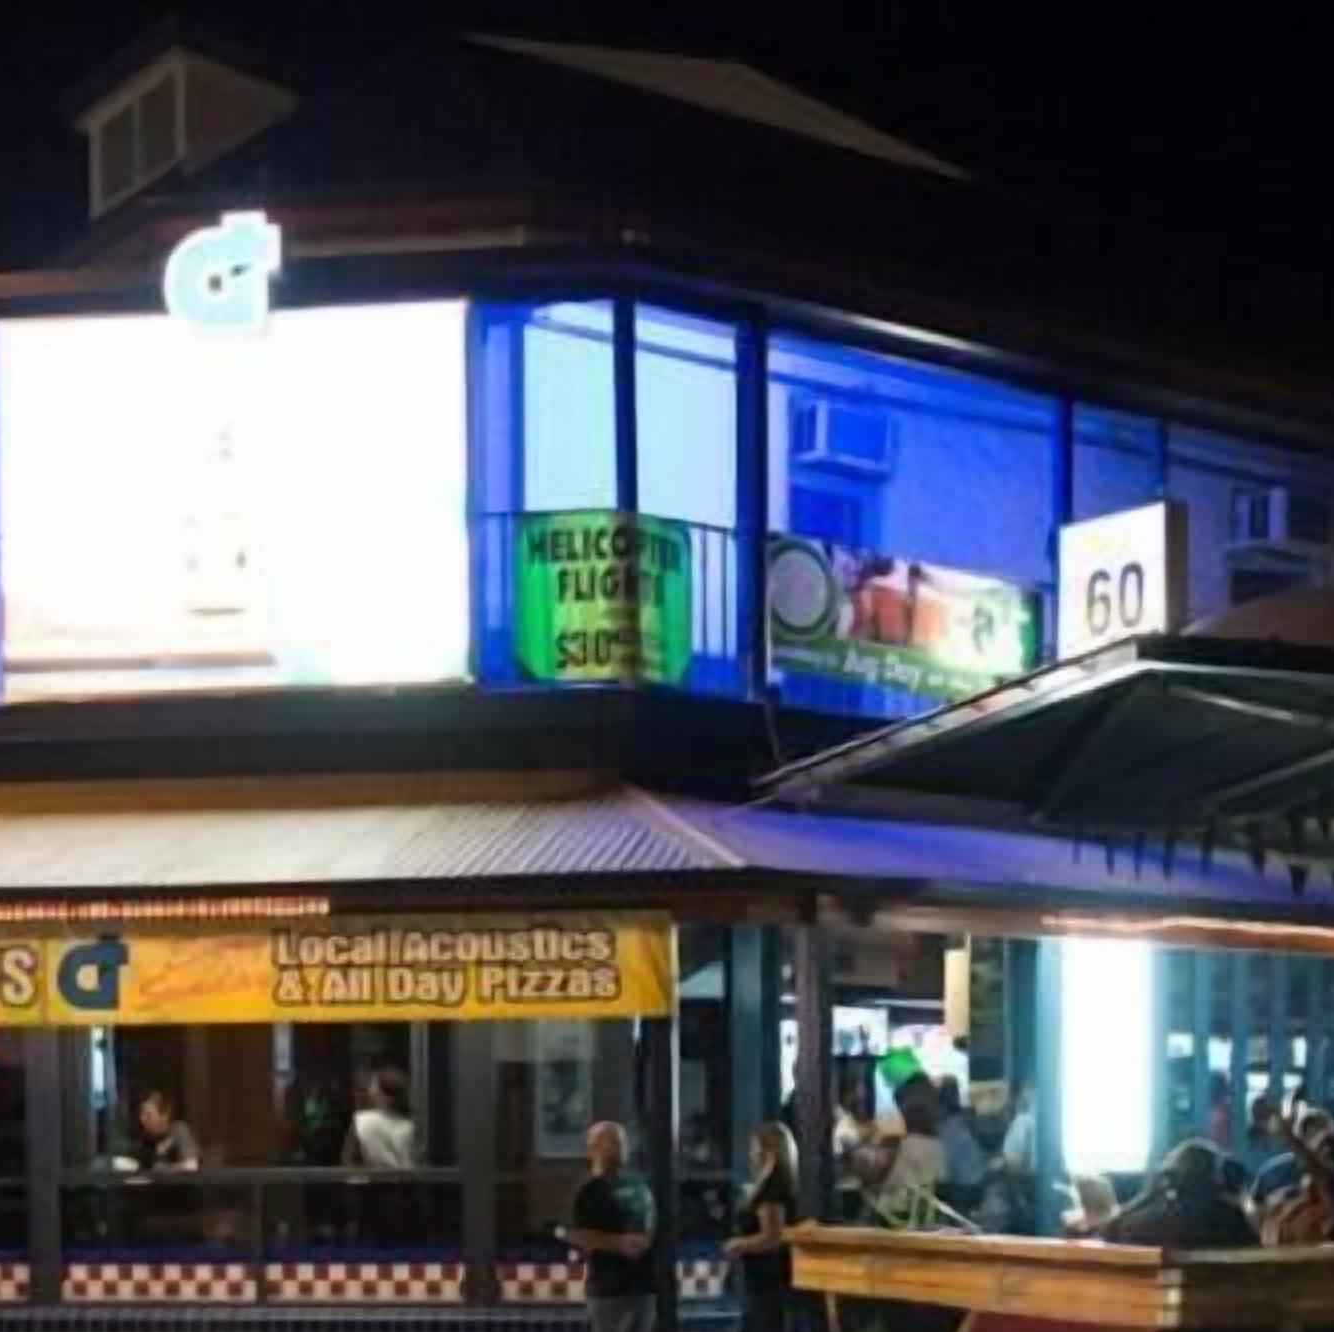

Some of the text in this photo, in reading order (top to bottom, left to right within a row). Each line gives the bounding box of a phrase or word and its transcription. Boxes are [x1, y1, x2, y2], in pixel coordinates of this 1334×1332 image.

[1086, 560, 1146, 637] 60
[273, 927, 389, 966] Local
[402, 925, 614, 965] Acoustics
[274, 963, 619, 1006] & All Day Pizzas
